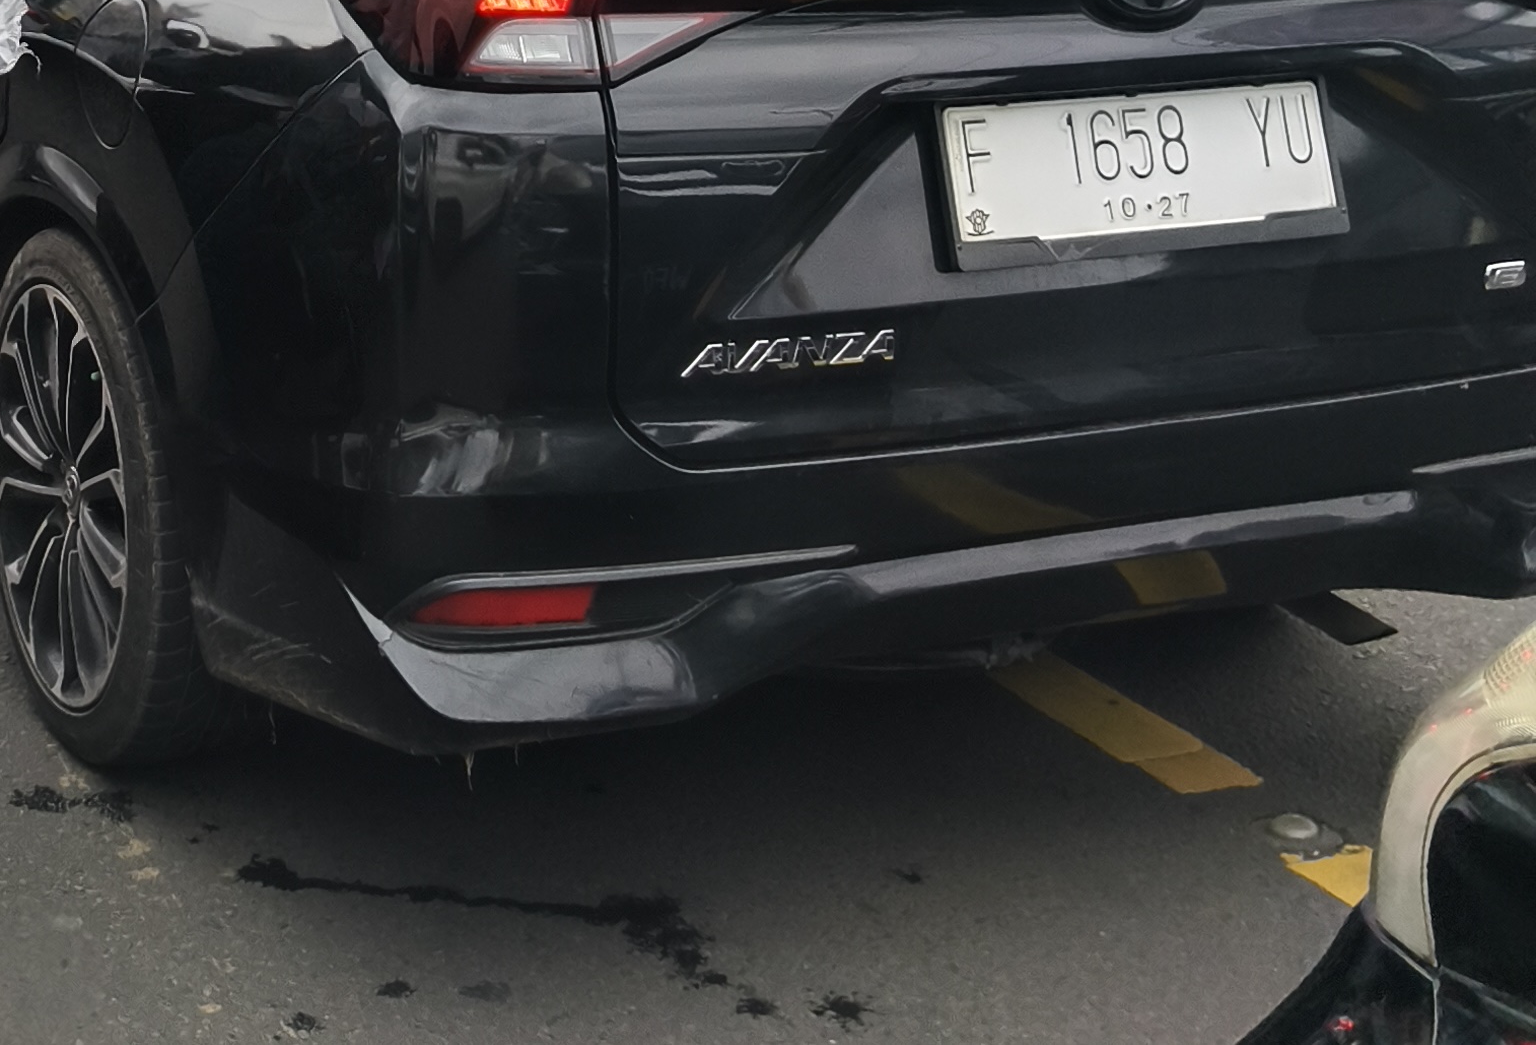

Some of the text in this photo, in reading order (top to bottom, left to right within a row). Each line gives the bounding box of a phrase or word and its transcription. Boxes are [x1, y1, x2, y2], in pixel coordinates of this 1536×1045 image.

[962, 93, 1314, 195] F 1658 YU
[680, 329, 896, 379] AVANZA
